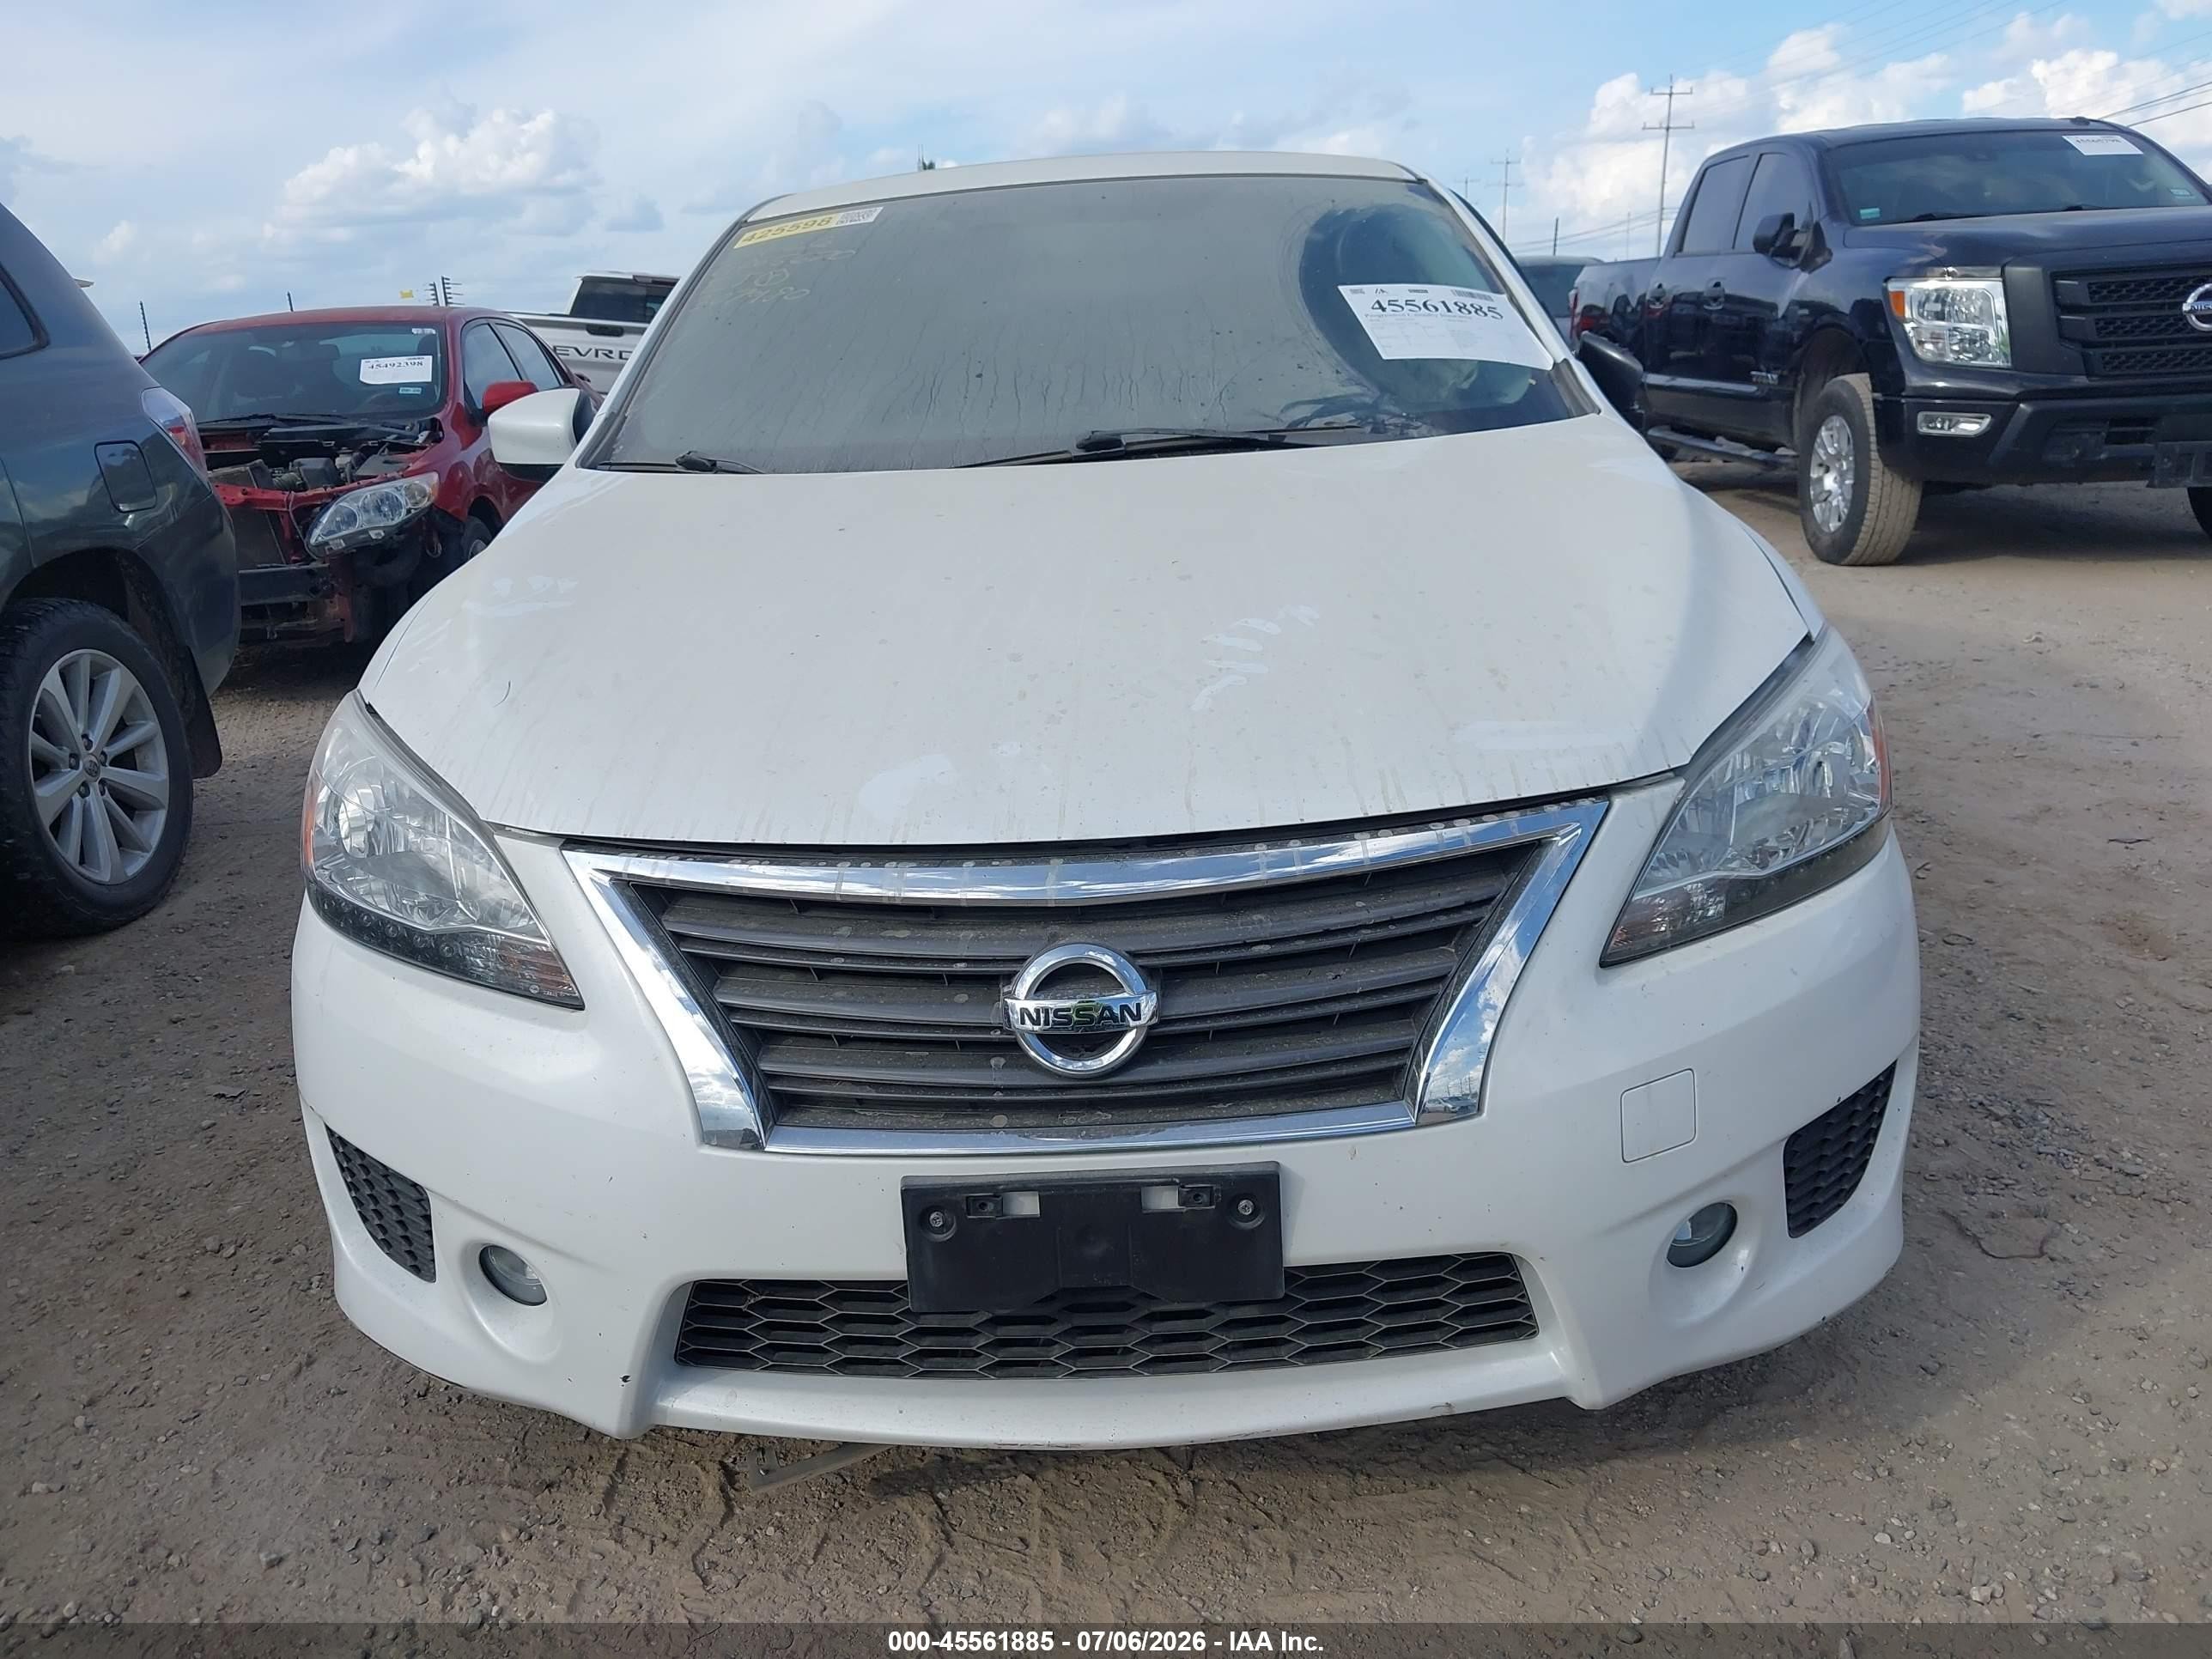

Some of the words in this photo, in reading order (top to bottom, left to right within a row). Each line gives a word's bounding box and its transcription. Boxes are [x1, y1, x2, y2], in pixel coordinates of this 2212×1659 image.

[741, 216, 833, 243] 425598
[1371, 299, 1504, 320] 45561885
[1019, 1002, 1142, 1026] NISSAN
